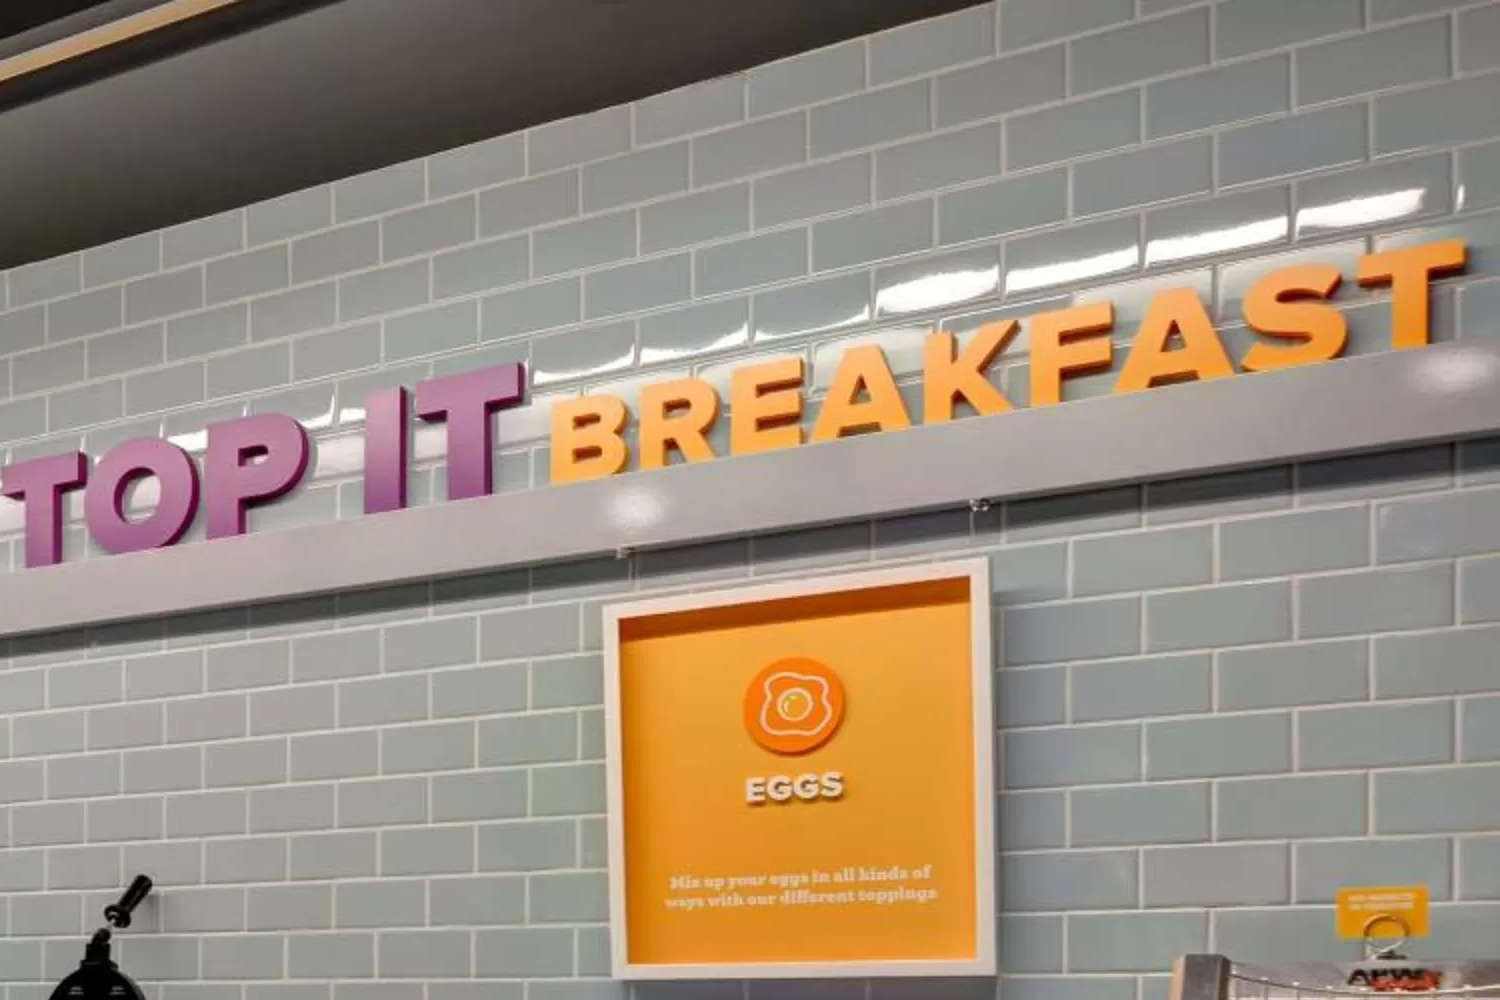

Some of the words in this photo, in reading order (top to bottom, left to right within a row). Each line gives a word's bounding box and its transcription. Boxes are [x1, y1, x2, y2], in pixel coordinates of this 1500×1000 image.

[2, 411, 309, 569] TOP
[363, 361, 526, 514] IT
[550, 239, 1469, 484] BREAKFAST
[745, 770, 845, 804] EGGS
[669, 874, 700, 890] Mix
[703, 876, 725, 892] up
[726, 874, 766, 892] your
[769, 872, 809, 889] eggs
[812, 868, 831, 883] in
[833, 867, 855, 883] all
[858, 865, 909, 882] kinds
[911, 864, 933, 880] of
[707, 891, 742, 907] with
[745, 894, 776, 906] our
[779, 887, 856, 905] different
[857, 885, 939, 905] toppings
